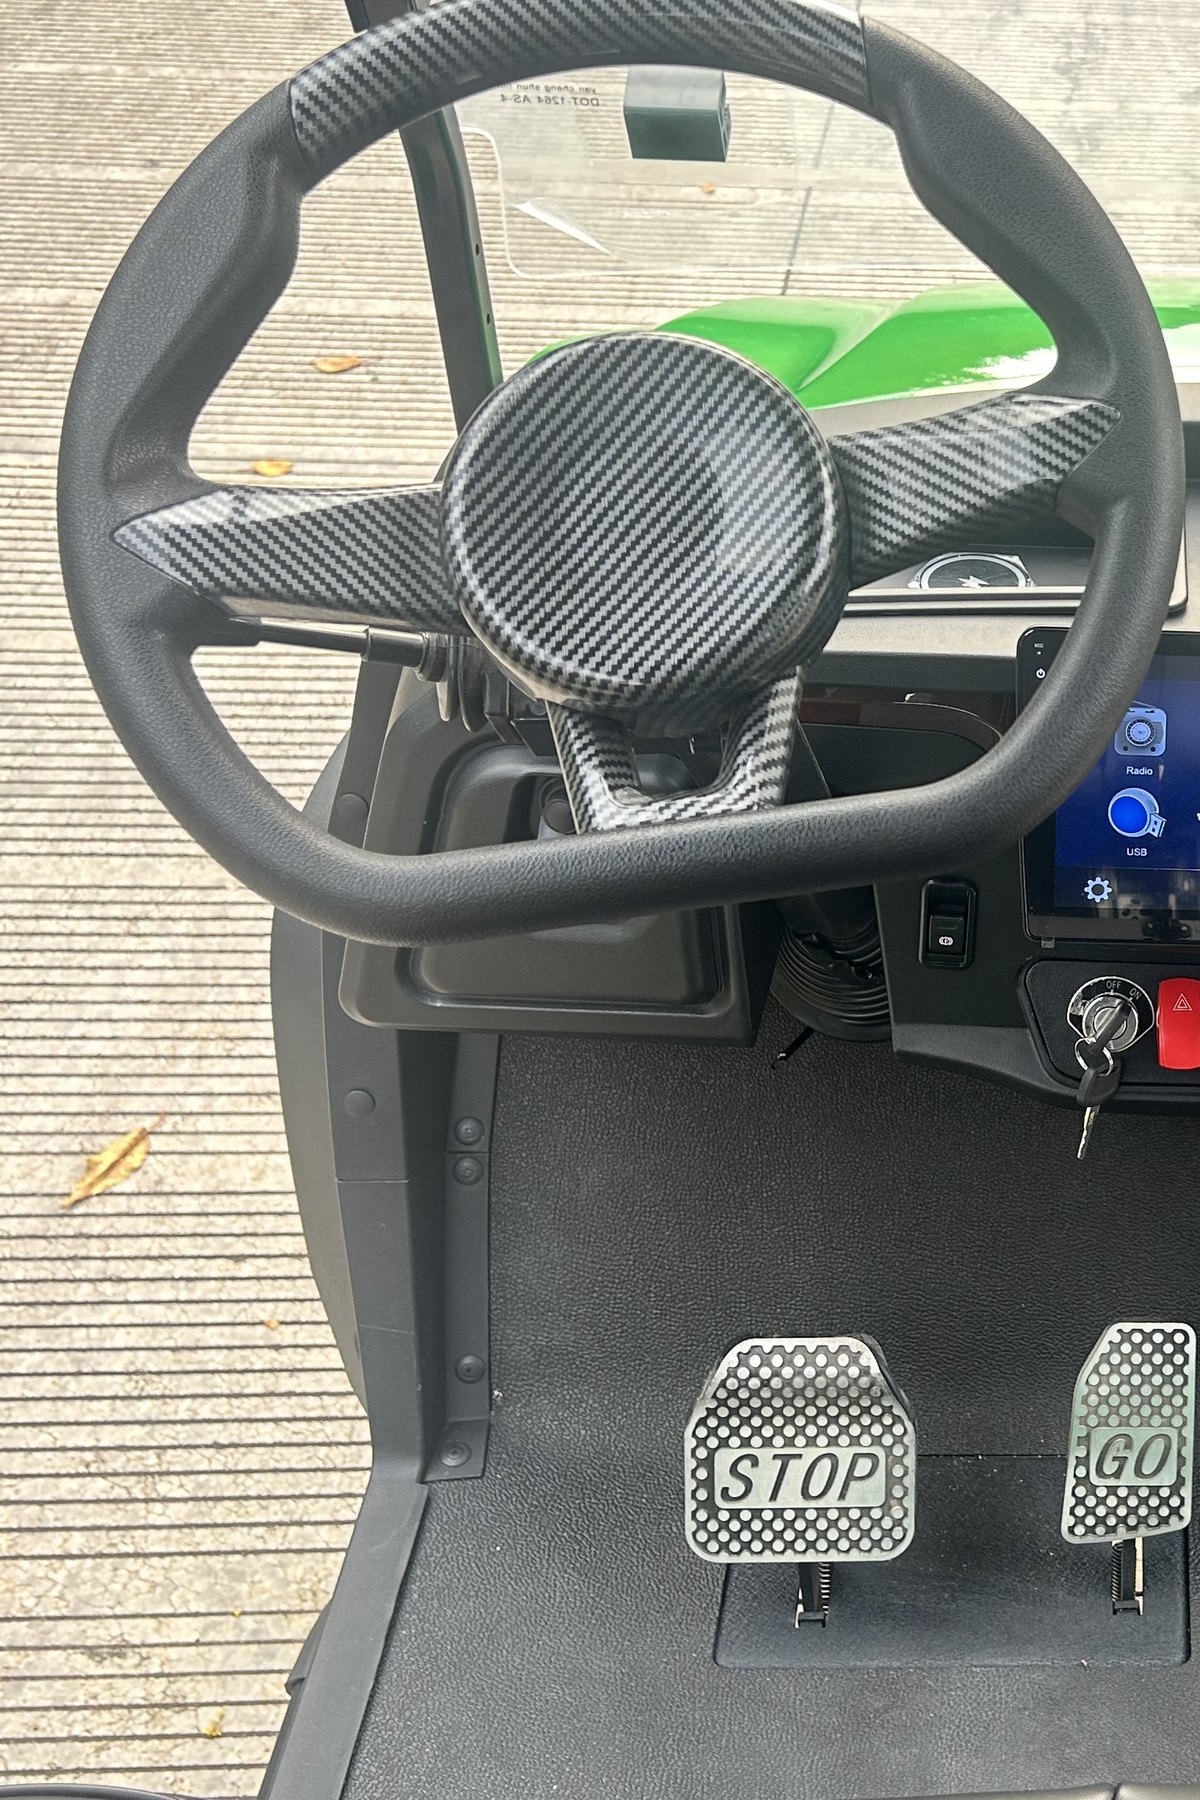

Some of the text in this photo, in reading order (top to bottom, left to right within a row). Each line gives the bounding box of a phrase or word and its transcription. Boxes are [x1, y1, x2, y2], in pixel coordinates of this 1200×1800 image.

[1126, 766, 1153, 776] Radio
[1126, 847, 1148, 857] USB
[1105, 980, 1121, 990] OFF
[1129, 987, 1142, 1000] ON
[1095, 1433, 1173, 1480] GO
[720, 1452, 880, 1503] STOP
